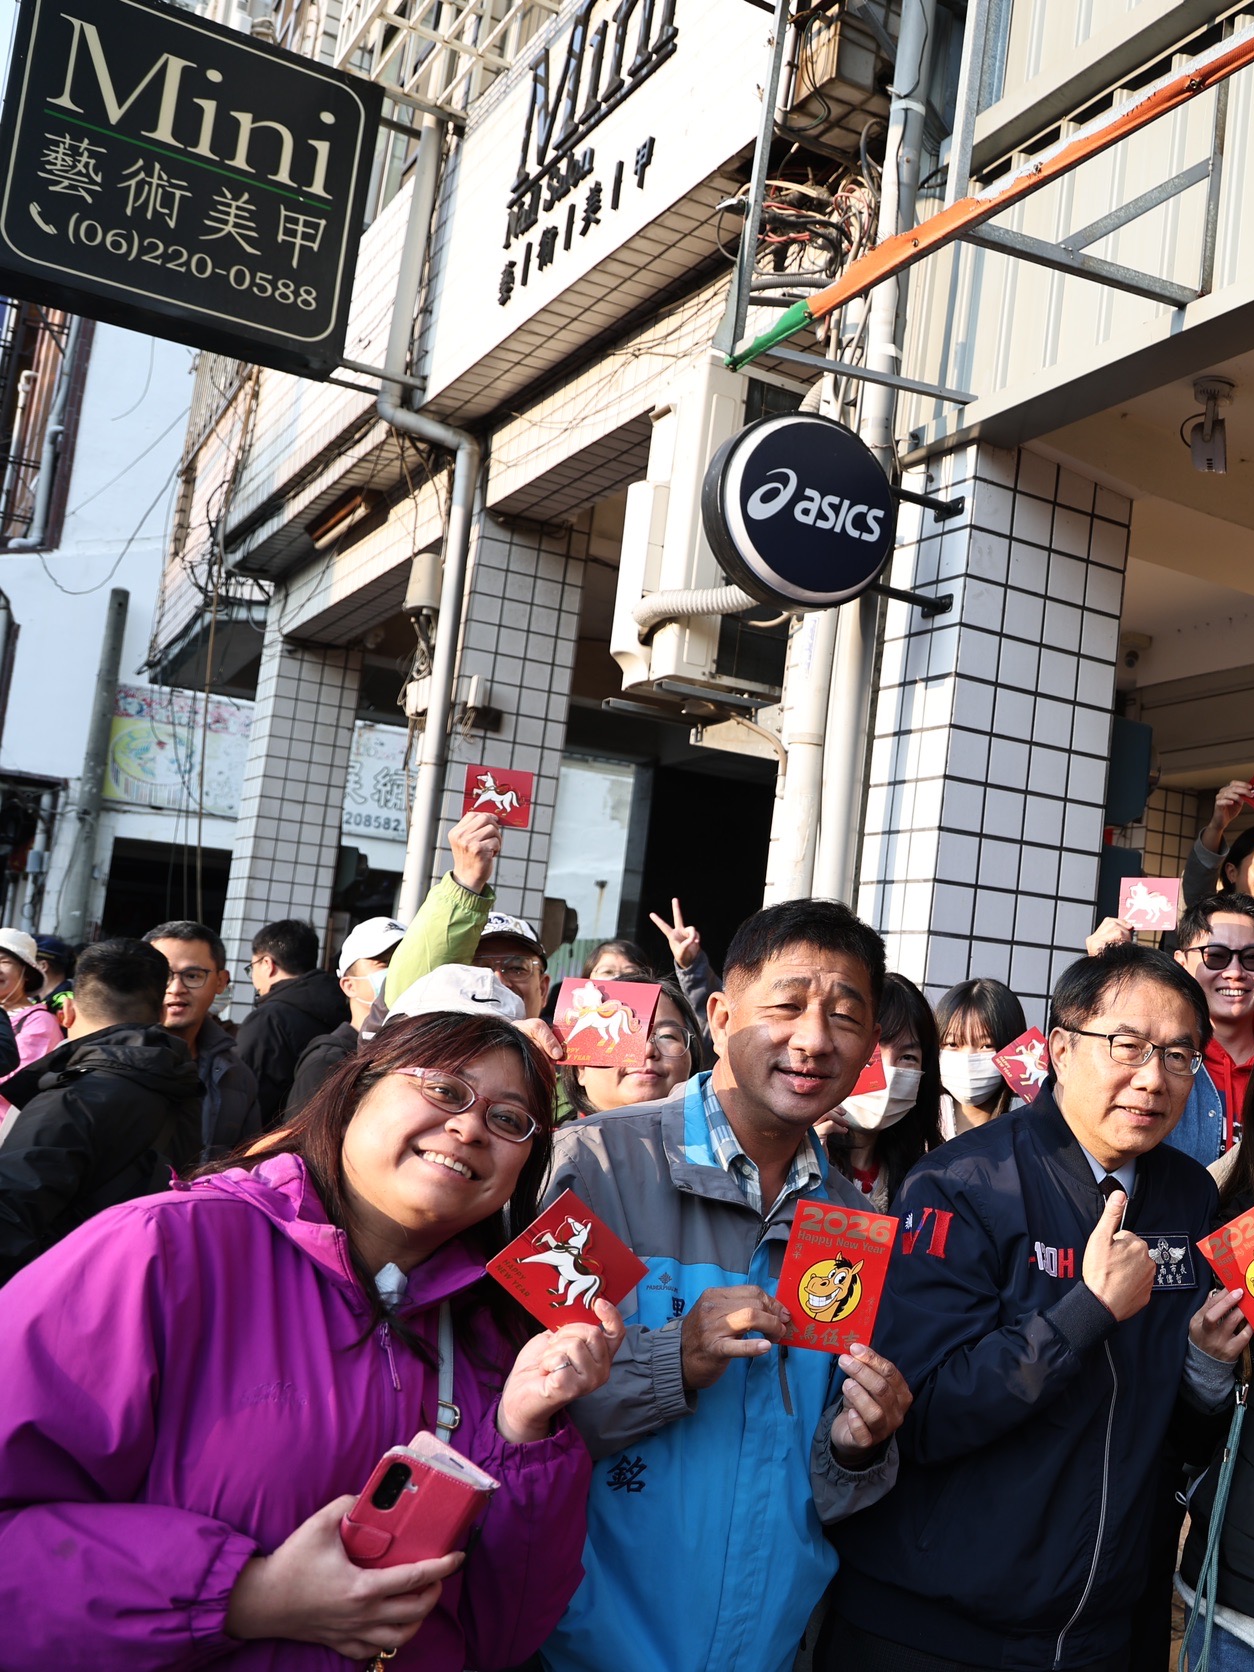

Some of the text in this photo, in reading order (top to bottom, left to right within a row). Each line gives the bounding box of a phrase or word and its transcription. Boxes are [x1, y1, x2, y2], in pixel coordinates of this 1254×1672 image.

[46, 12, 337, 200] Mini
[37, 132, 327, 270] 藝術美甲
[67, 211, 318, 311] (06)220-0588
[797, 1231, 887, 1254] Happy New Year
[799, 1206, 890, 1244] 2026
[495, 1264, 531, 1298] NEW YEAR
[501, 1258, 527, 1281] HAPPY
[606, 1454, 648, 1493] 銘
